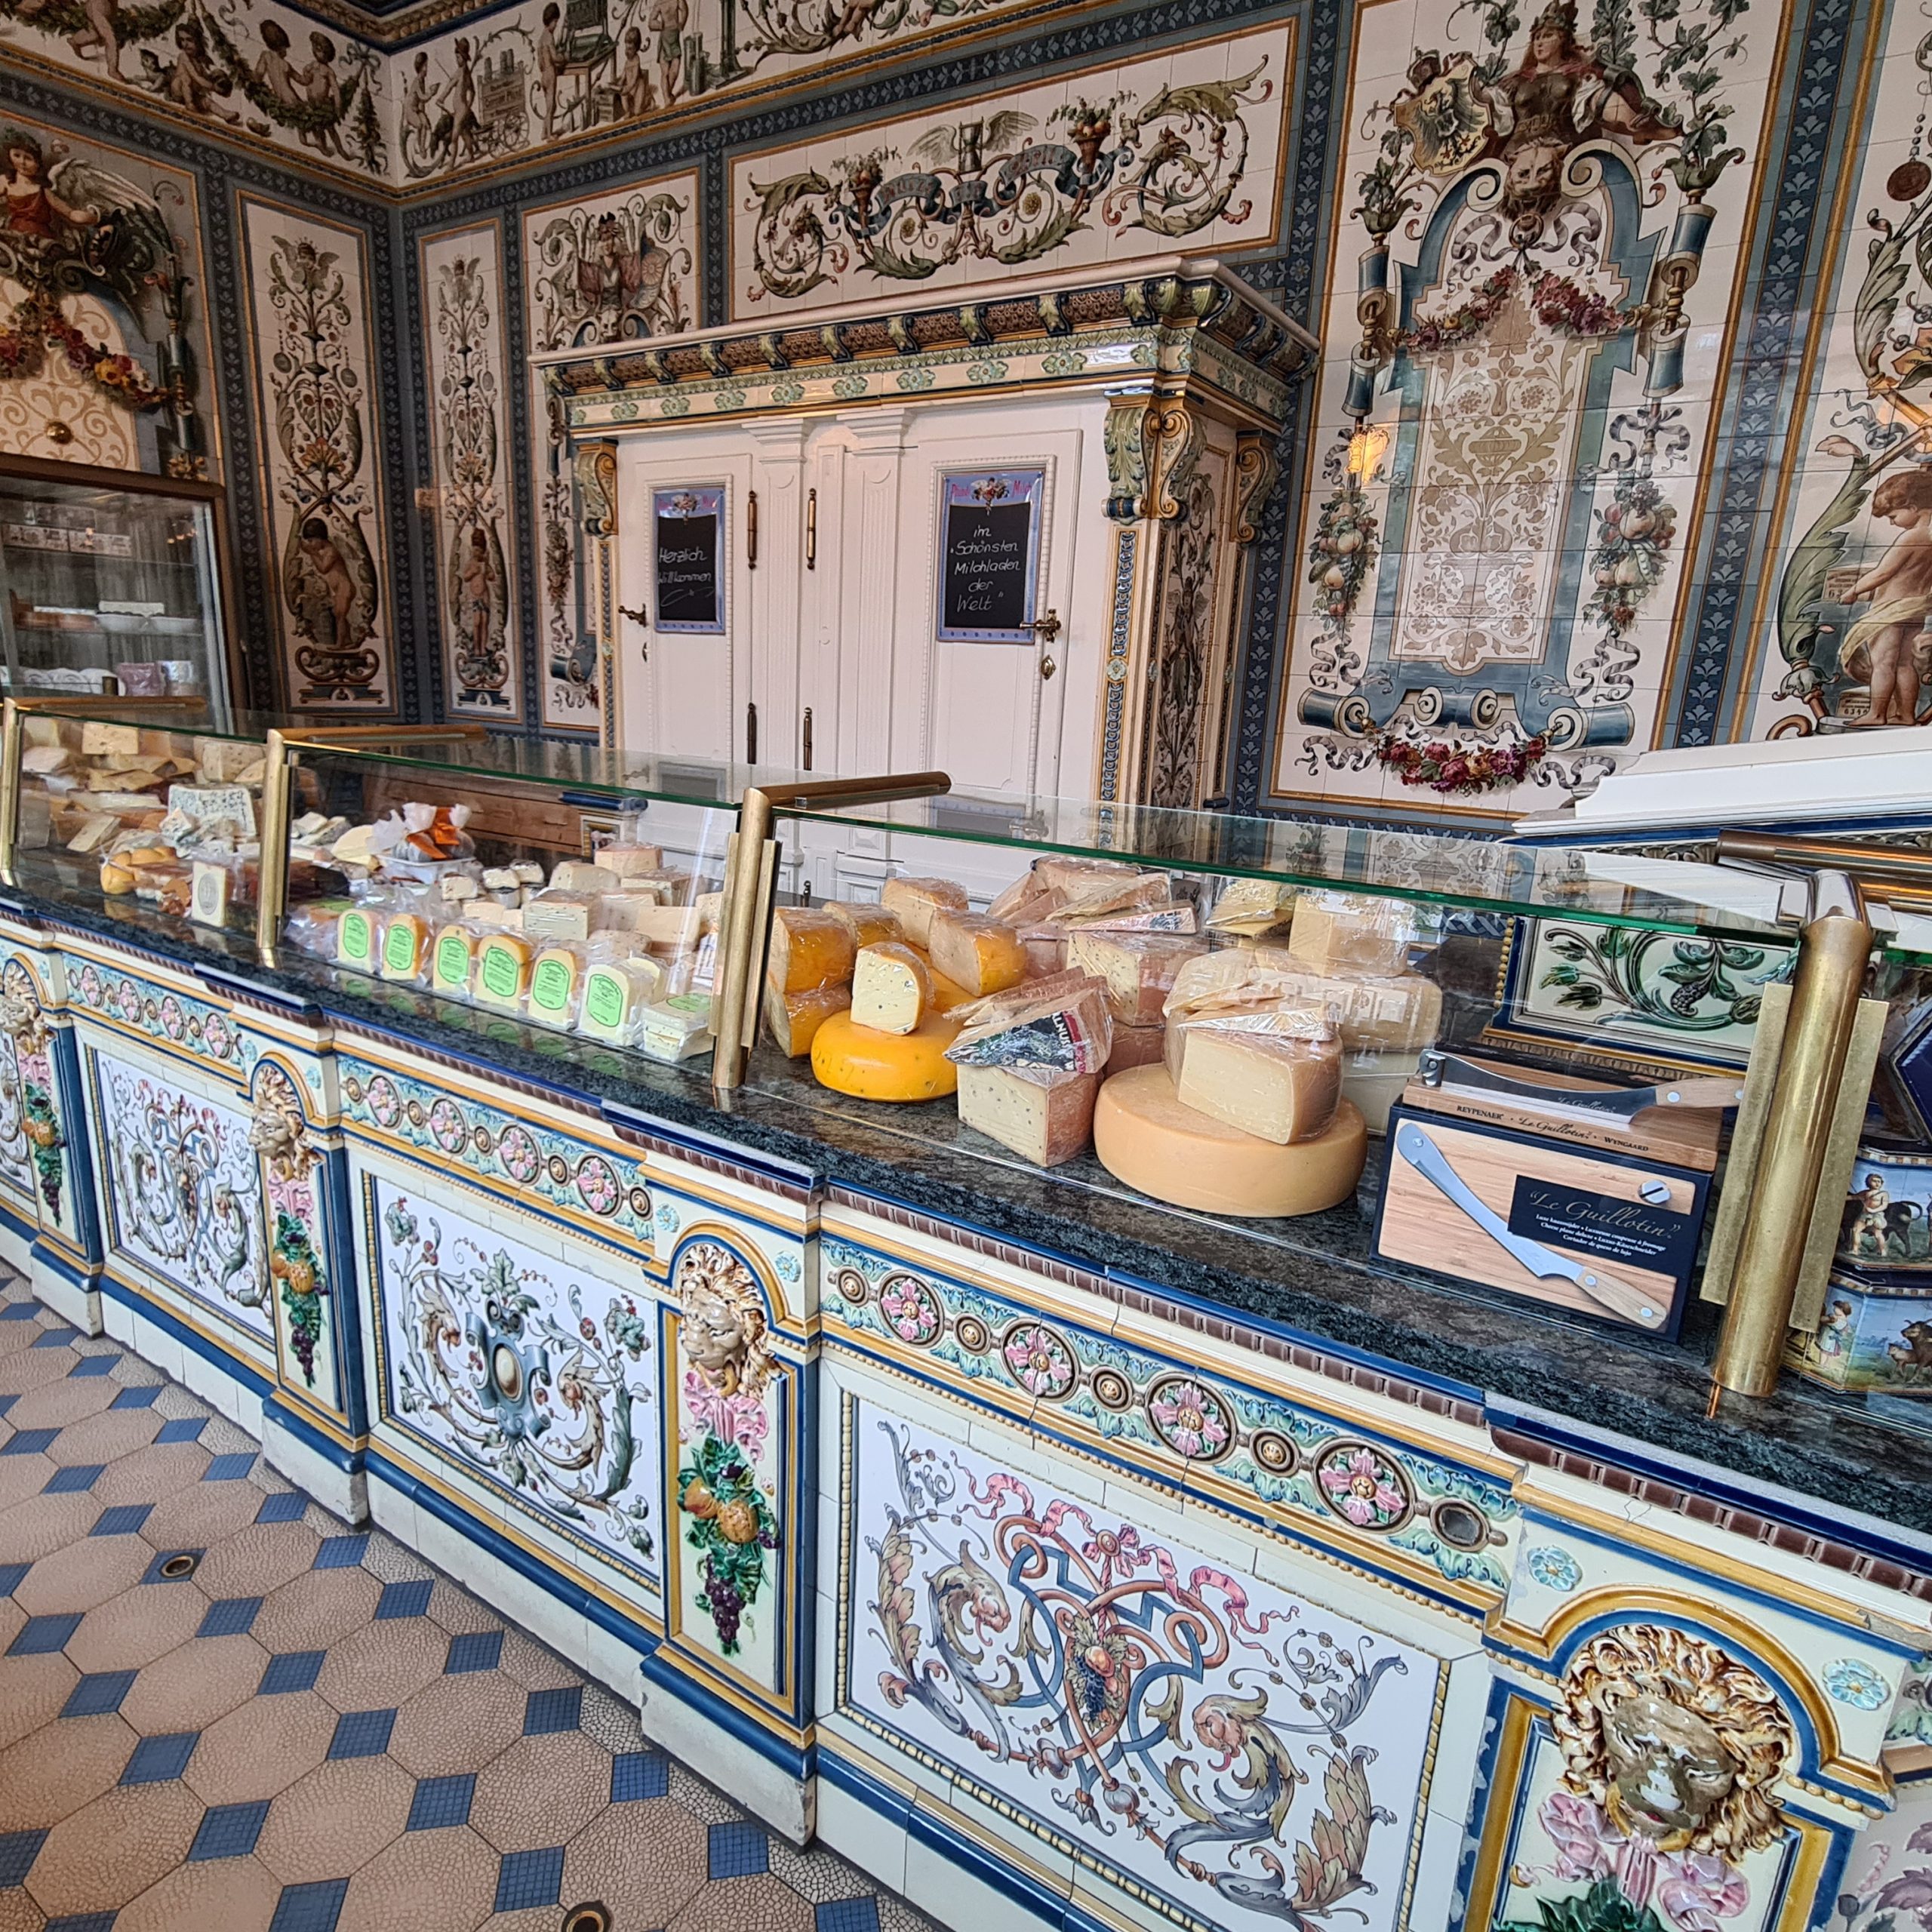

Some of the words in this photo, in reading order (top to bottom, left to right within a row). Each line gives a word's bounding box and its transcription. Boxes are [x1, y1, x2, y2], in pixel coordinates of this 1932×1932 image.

[974, 525, 992, 538] im
[658, 546, 708, 564] Herzlich
[954, 558, 1020, 575] Milchladen
[968, 579, 993, 592] der
[1604, 1137, 1649, 1152] WYNGAARD
